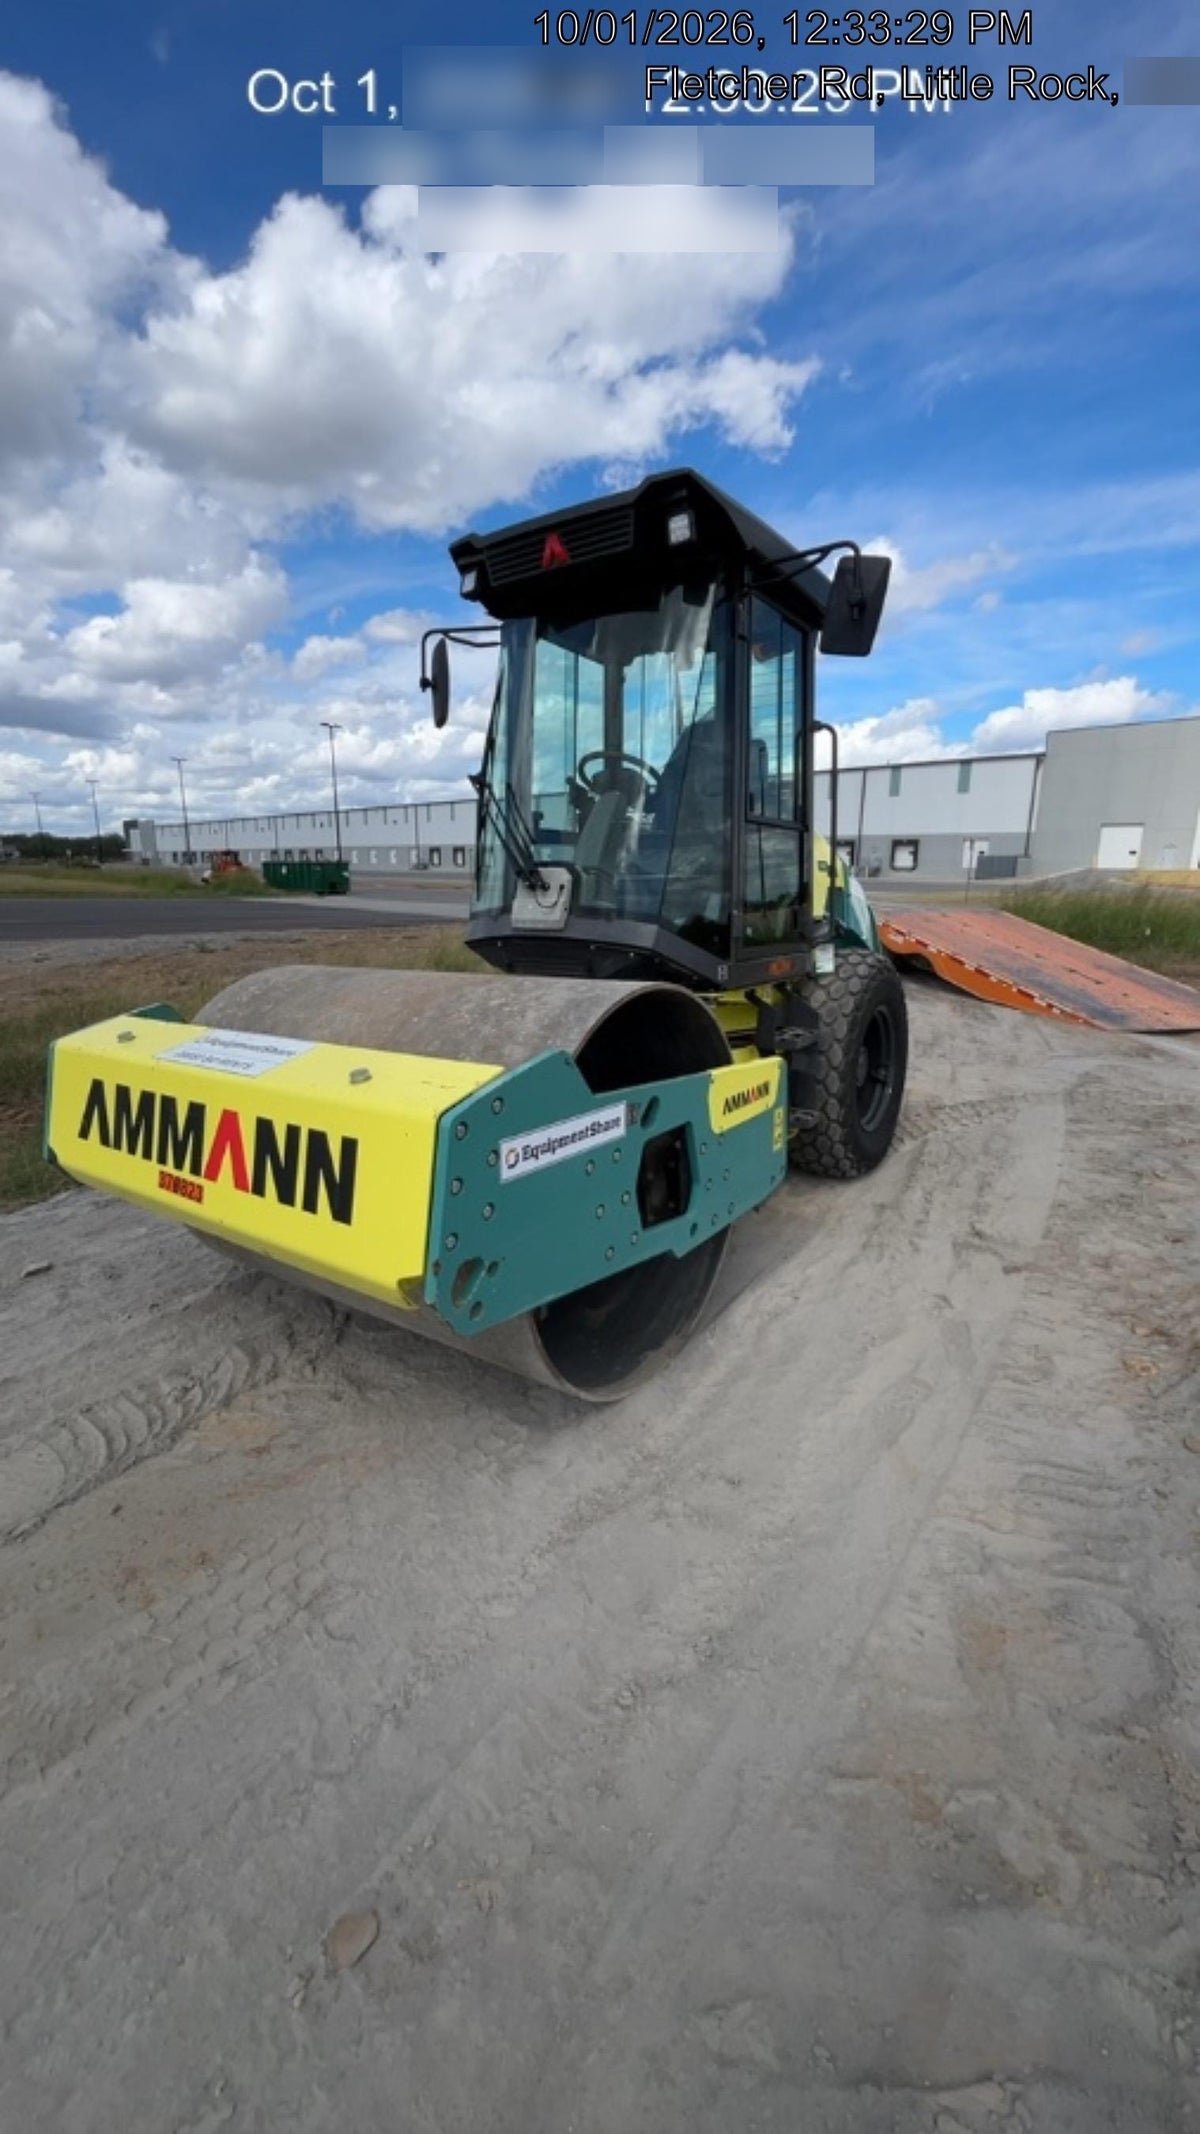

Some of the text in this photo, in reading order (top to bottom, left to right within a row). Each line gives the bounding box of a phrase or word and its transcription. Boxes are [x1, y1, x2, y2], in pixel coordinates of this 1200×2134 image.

[722, 1080, 770, 1116] AMMANN
[77, 1078, 359, 1226] AMMANN
[521, 1116, 621, 1162] EquipmentShare
